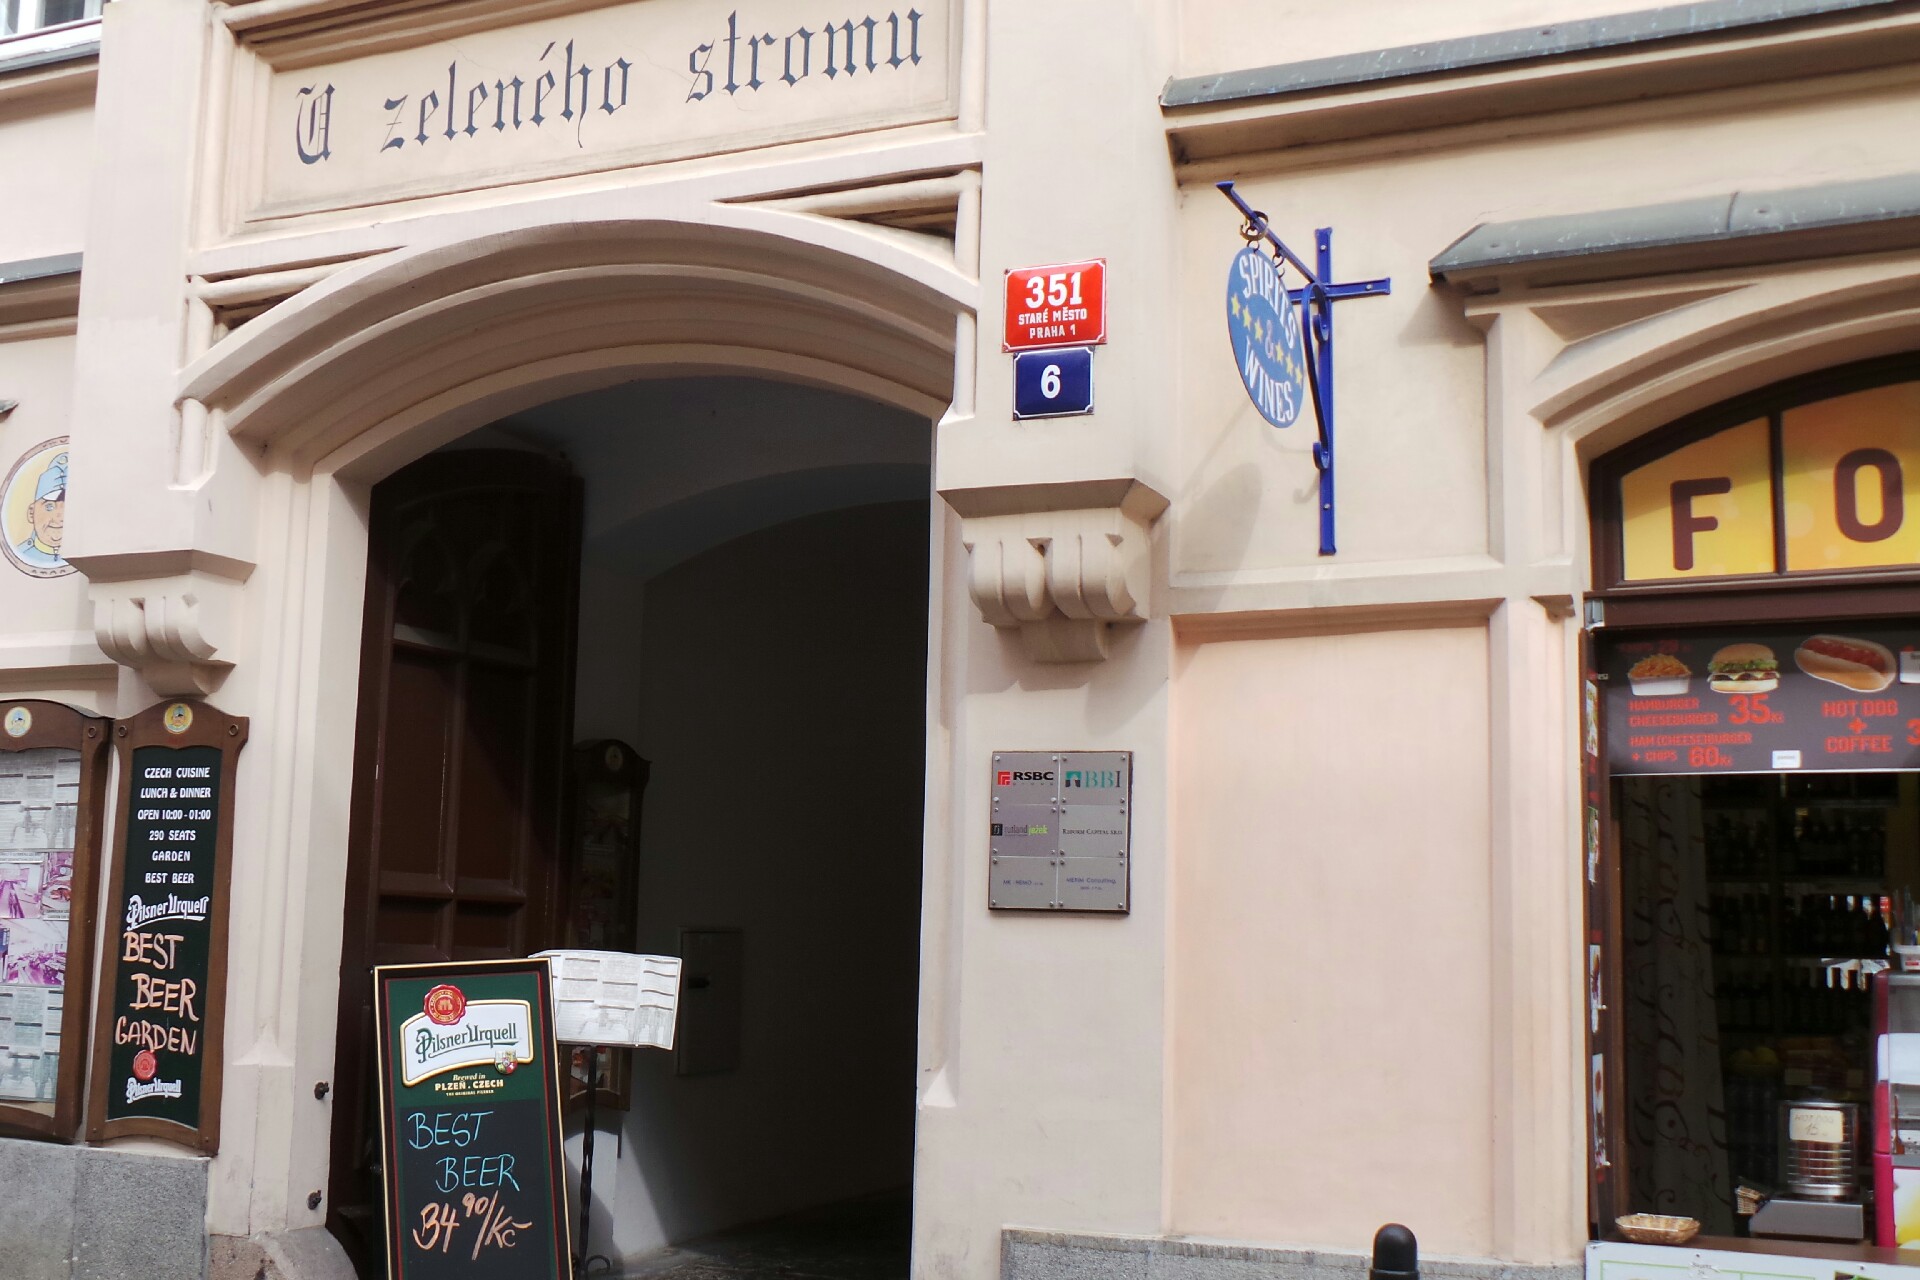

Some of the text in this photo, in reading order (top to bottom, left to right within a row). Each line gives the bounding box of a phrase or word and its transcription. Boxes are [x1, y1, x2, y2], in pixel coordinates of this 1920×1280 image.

[295, 6, 926, 165] U zeleného stromu
[1025, 271, 1083, 309] 351
[1238, 253, 1297, 350] SPIRITS
[1018, 307, 1088, 326] STARÉ MĚSTO
[1029, 323, 1077, 339] PRAHA 1
[1264, 319, 1276, 362] &
[1040, 364, 1061, 399] 6
[1244, 334, 1295, 423] WINES
[1628, 697, 1700, 711] HAMBURGER
[1822, 699, 1899, 718] HOT DOG
[1628, 712, 1719, 728] CHEESEBURGER
[1825, 735, 1893, 753] COFFEE
[1645, 750, 1678, 762] CHIPS
[144, 766, 211, 779] CZECH CUISINE
[1012, 771, 1055, 781] RSBC
[1085, 770, 1121, 788] BBI
[140, 787, 212, 799] LUNCH & DINNER
[137, 809, 160, 820] OPEN
[161, 808, 183, 821] 10:00
[148, 829, 197, 842] 290 SEATS
[152, 849, 191, 862] GARDEN
[144, 872, 195, 884] BEST BEER
[126, 892, 210, 931] Pilsner Urquell
[122, 931, 185, 971] BEST
[129, 973, 200, 1022] BEER
[114, 1015, 198, 1057] GARDEN
[415, 1023, 518, 1064] Pilsner Urquell
[453, 1072, 486, 1081] Brewed in
[472, 1079, 504, 1089] CZECH
[126, 1077, 182, 1104] Pilsner Urquell
[407, 1110, 494, 1149] BEST
[435, 1153, 520, 1192] BEER
